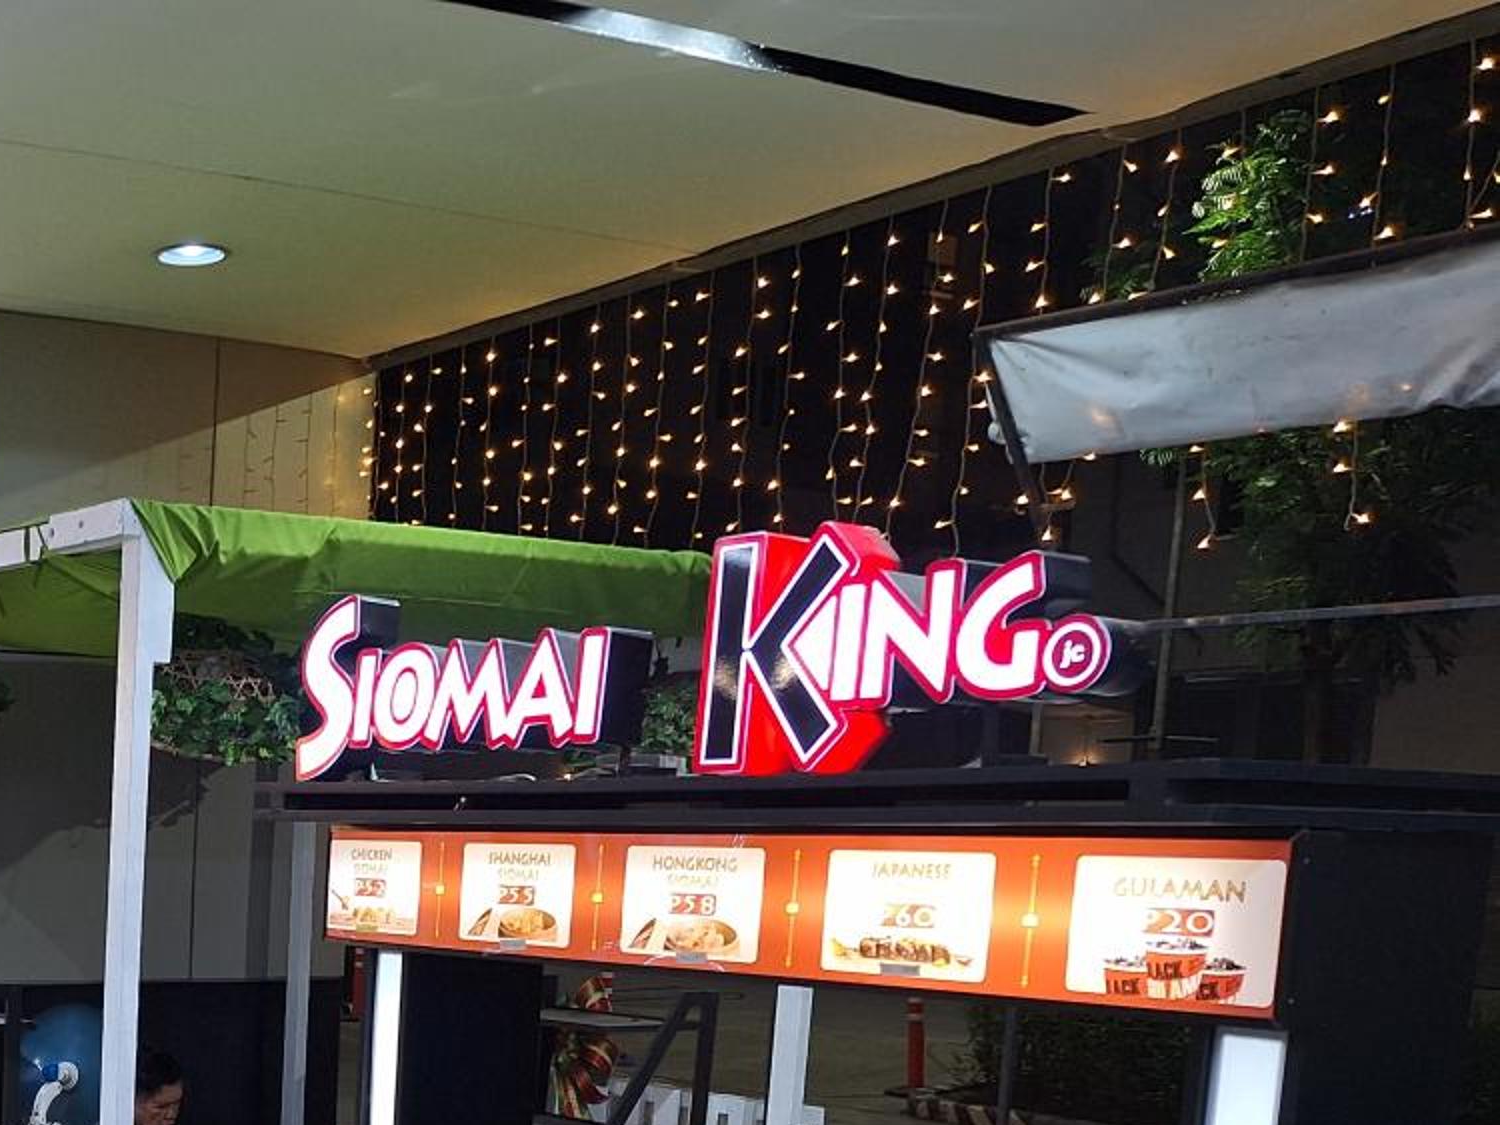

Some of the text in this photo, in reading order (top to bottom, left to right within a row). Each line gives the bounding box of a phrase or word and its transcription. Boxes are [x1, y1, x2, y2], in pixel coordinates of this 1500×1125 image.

[295, 594, 611, 782] SIOMAI
[694, 521, 1053, 775] KING
[488, 851, 552, 865] SHANGHAI
[652, 854, 738, 873] HONGKONG
[871, 862, 952, 879] JAPANESE
[1113, 877, 1247, 902] GULAMAN
